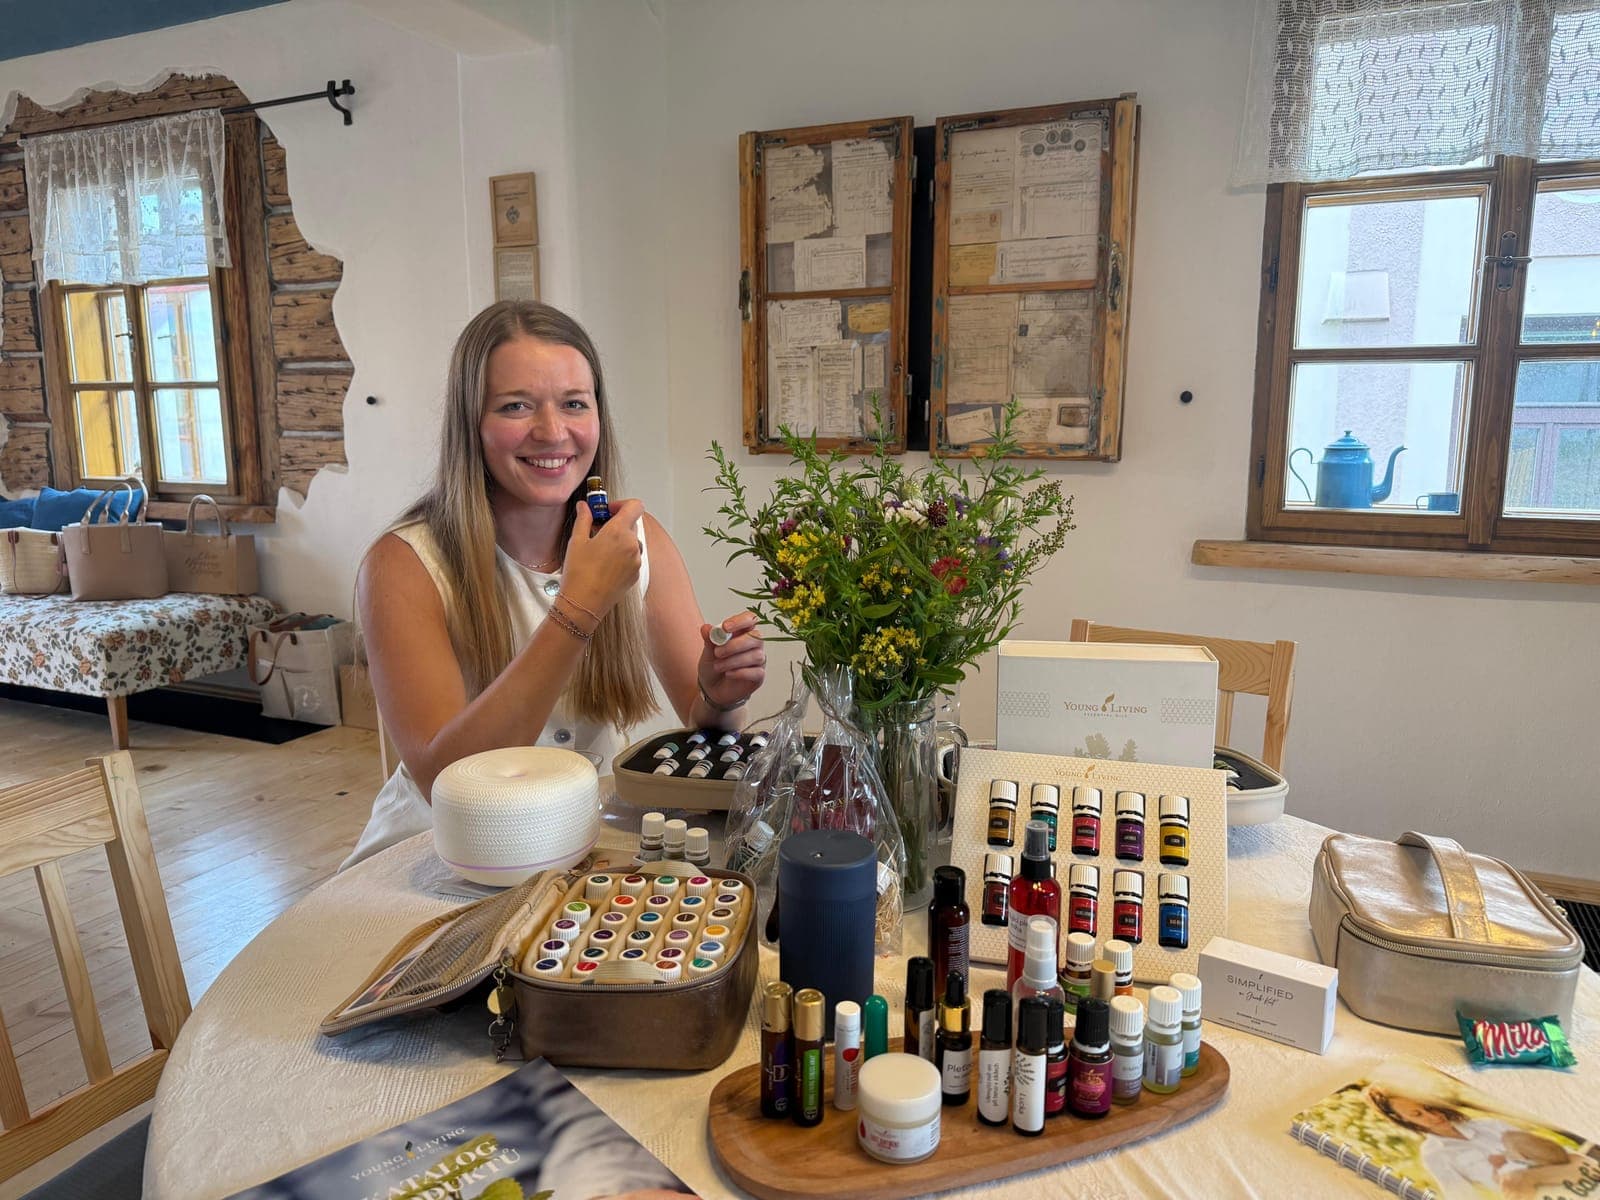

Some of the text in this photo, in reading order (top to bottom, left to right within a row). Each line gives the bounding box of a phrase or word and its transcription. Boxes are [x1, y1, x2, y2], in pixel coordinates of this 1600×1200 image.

[1064, 701, 1148, 714] YOUNG LIVING
[1055, 767, 1121, 781] YOUNG LIVING
[1226, 974, 1295, 1001] SIMPLIFIED
[1473, 1018, 1551, 1060] Mila
[351, 1127, 466, 1181] YOUNG LIVING
